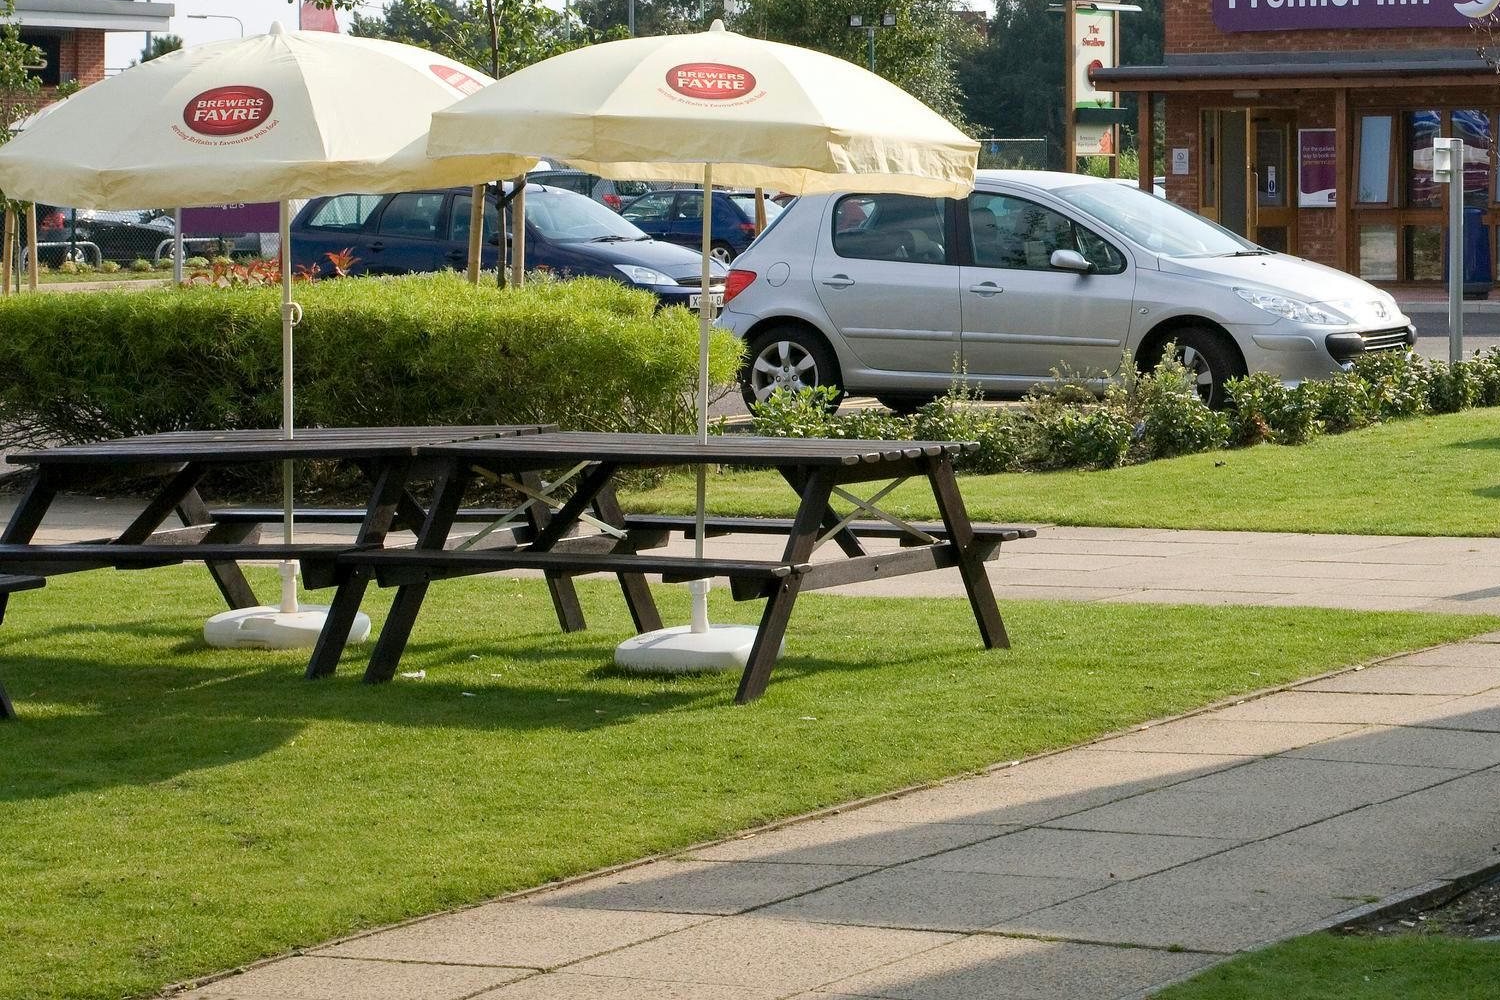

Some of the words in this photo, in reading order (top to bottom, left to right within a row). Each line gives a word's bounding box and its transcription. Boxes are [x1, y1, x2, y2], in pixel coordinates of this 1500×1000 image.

[1088, 24, 1100, 34] The
[1082, 37, 1105, 47] Swallow
[677, 70, 745, 80] BREWERS
[677, 78, 745, 90] FAYRE
[196, 98, 264, 108] BREWERS
[193, 107, 262, 122] FAYRE
